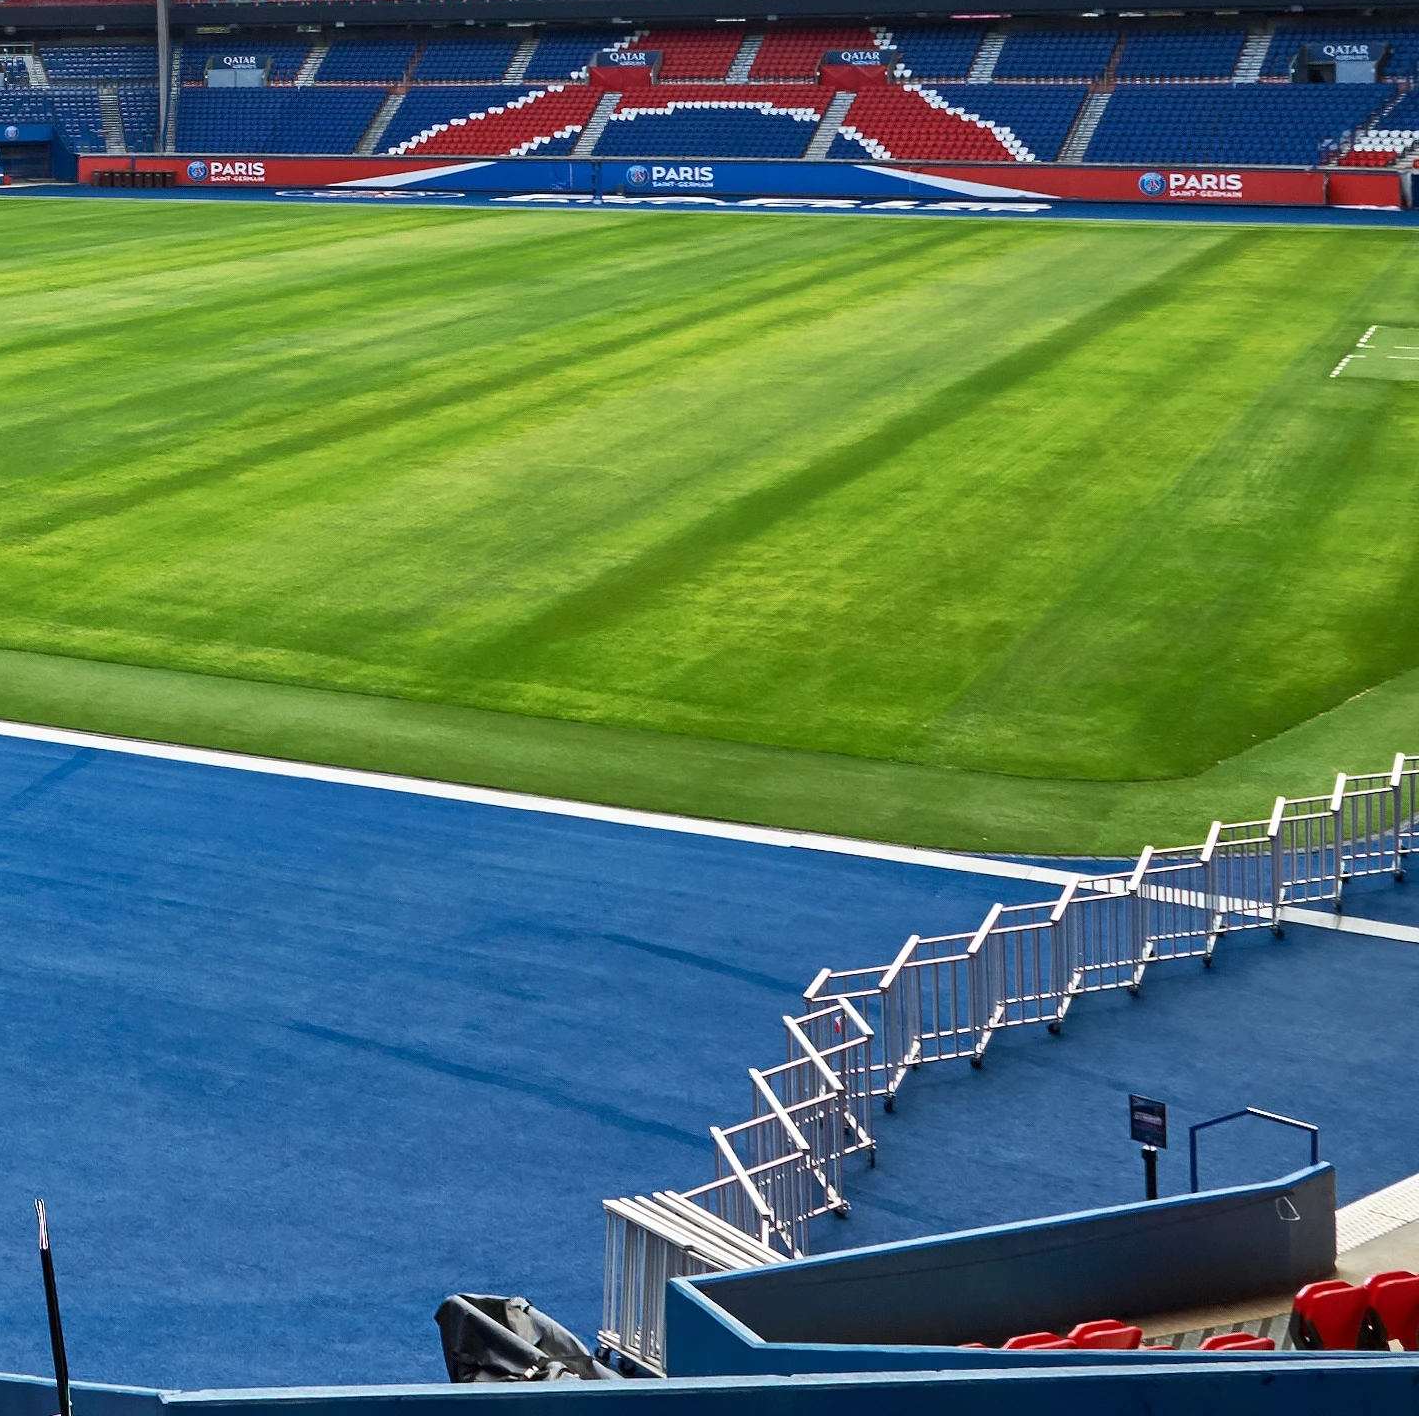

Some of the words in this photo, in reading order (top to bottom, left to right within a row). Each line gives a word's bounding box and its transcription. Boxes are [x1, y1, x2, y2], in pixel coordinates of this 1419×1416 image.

[610, 51, 645, 63] QATAR
[841, 51, 880, 63] QATAR
[1323, 44, 1369, 57] QATAR
[223, 56, 256, 66] QATAR
[210, 162, 266, 176] PARIS
[651, 166, 714, 181] PARIS
[1169, 173, 1243, 190] PARIS
